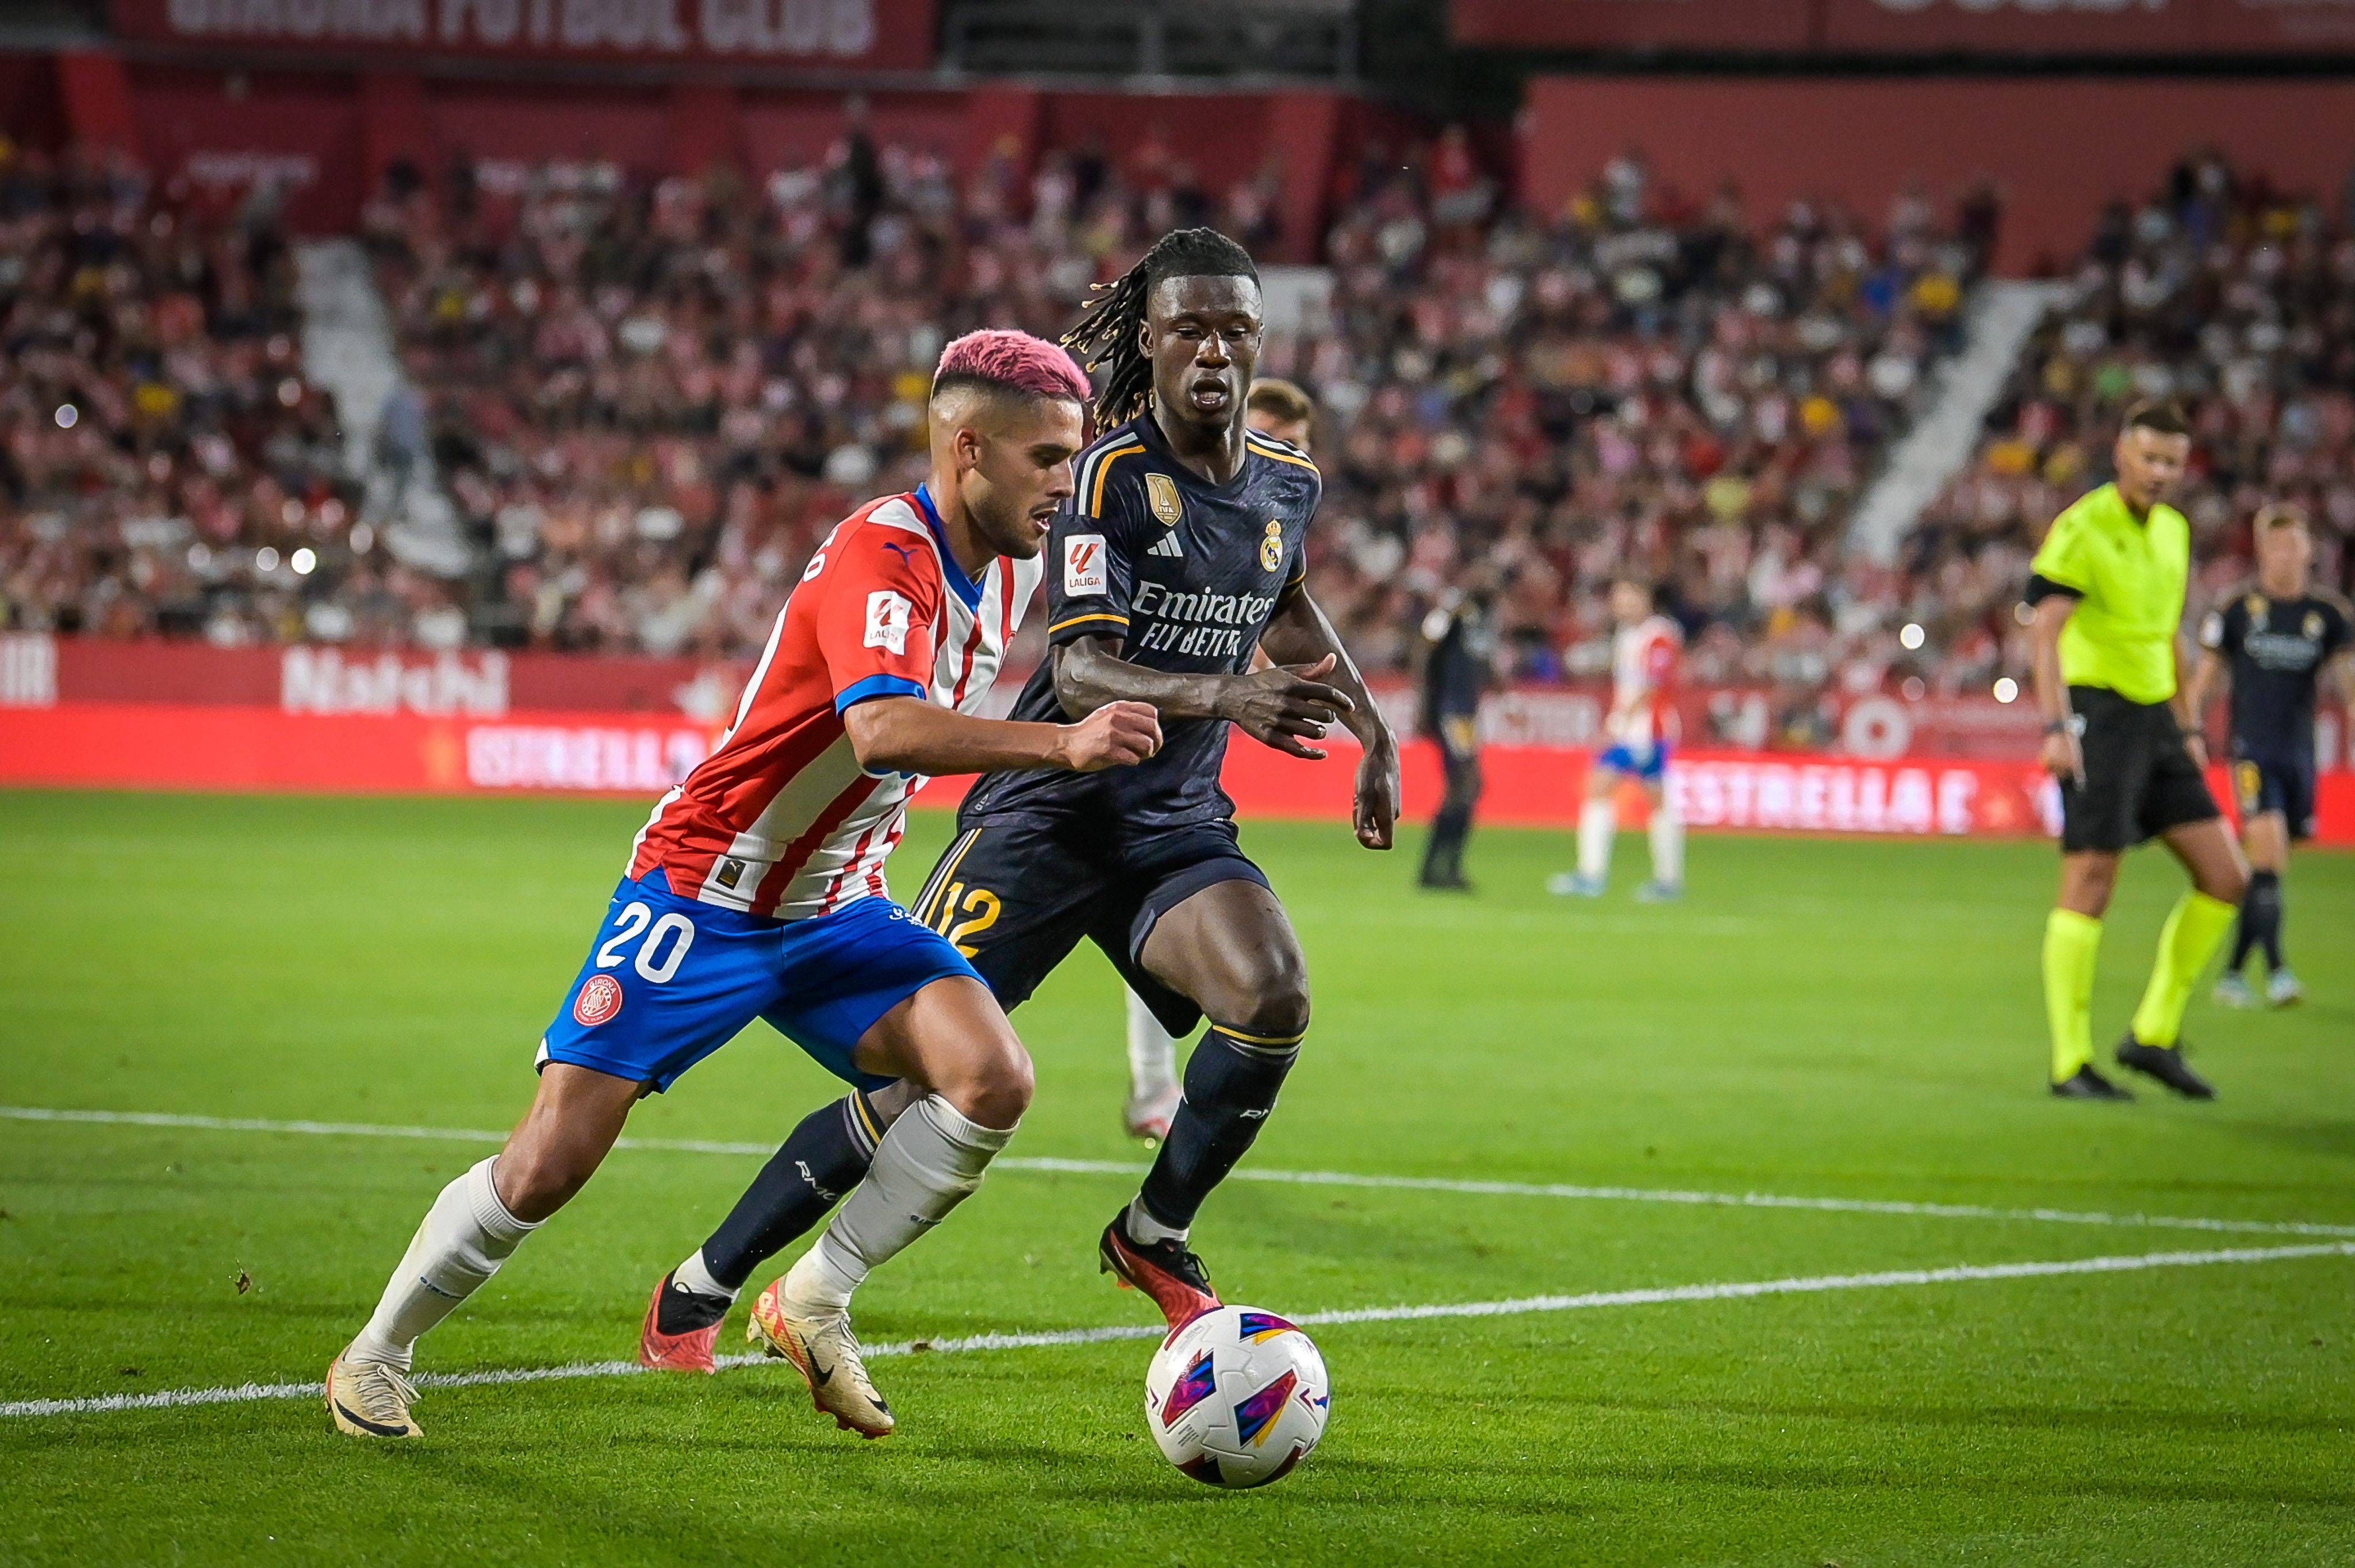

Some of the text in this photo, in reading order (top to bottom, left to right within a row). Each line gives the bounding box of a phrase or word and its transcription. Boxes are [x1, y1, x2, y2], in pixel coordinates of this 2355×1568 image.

[1069, 577, 1101, 588] LALIGA
[1132, 579, 1275, 625] Emirates
[1140, 622, 1242, 657] FLY BETTR
[937, 882, 1001, 958] 12
[596, 901, 695, 983] 20
[589, 979, 617, 994] GIRONA
